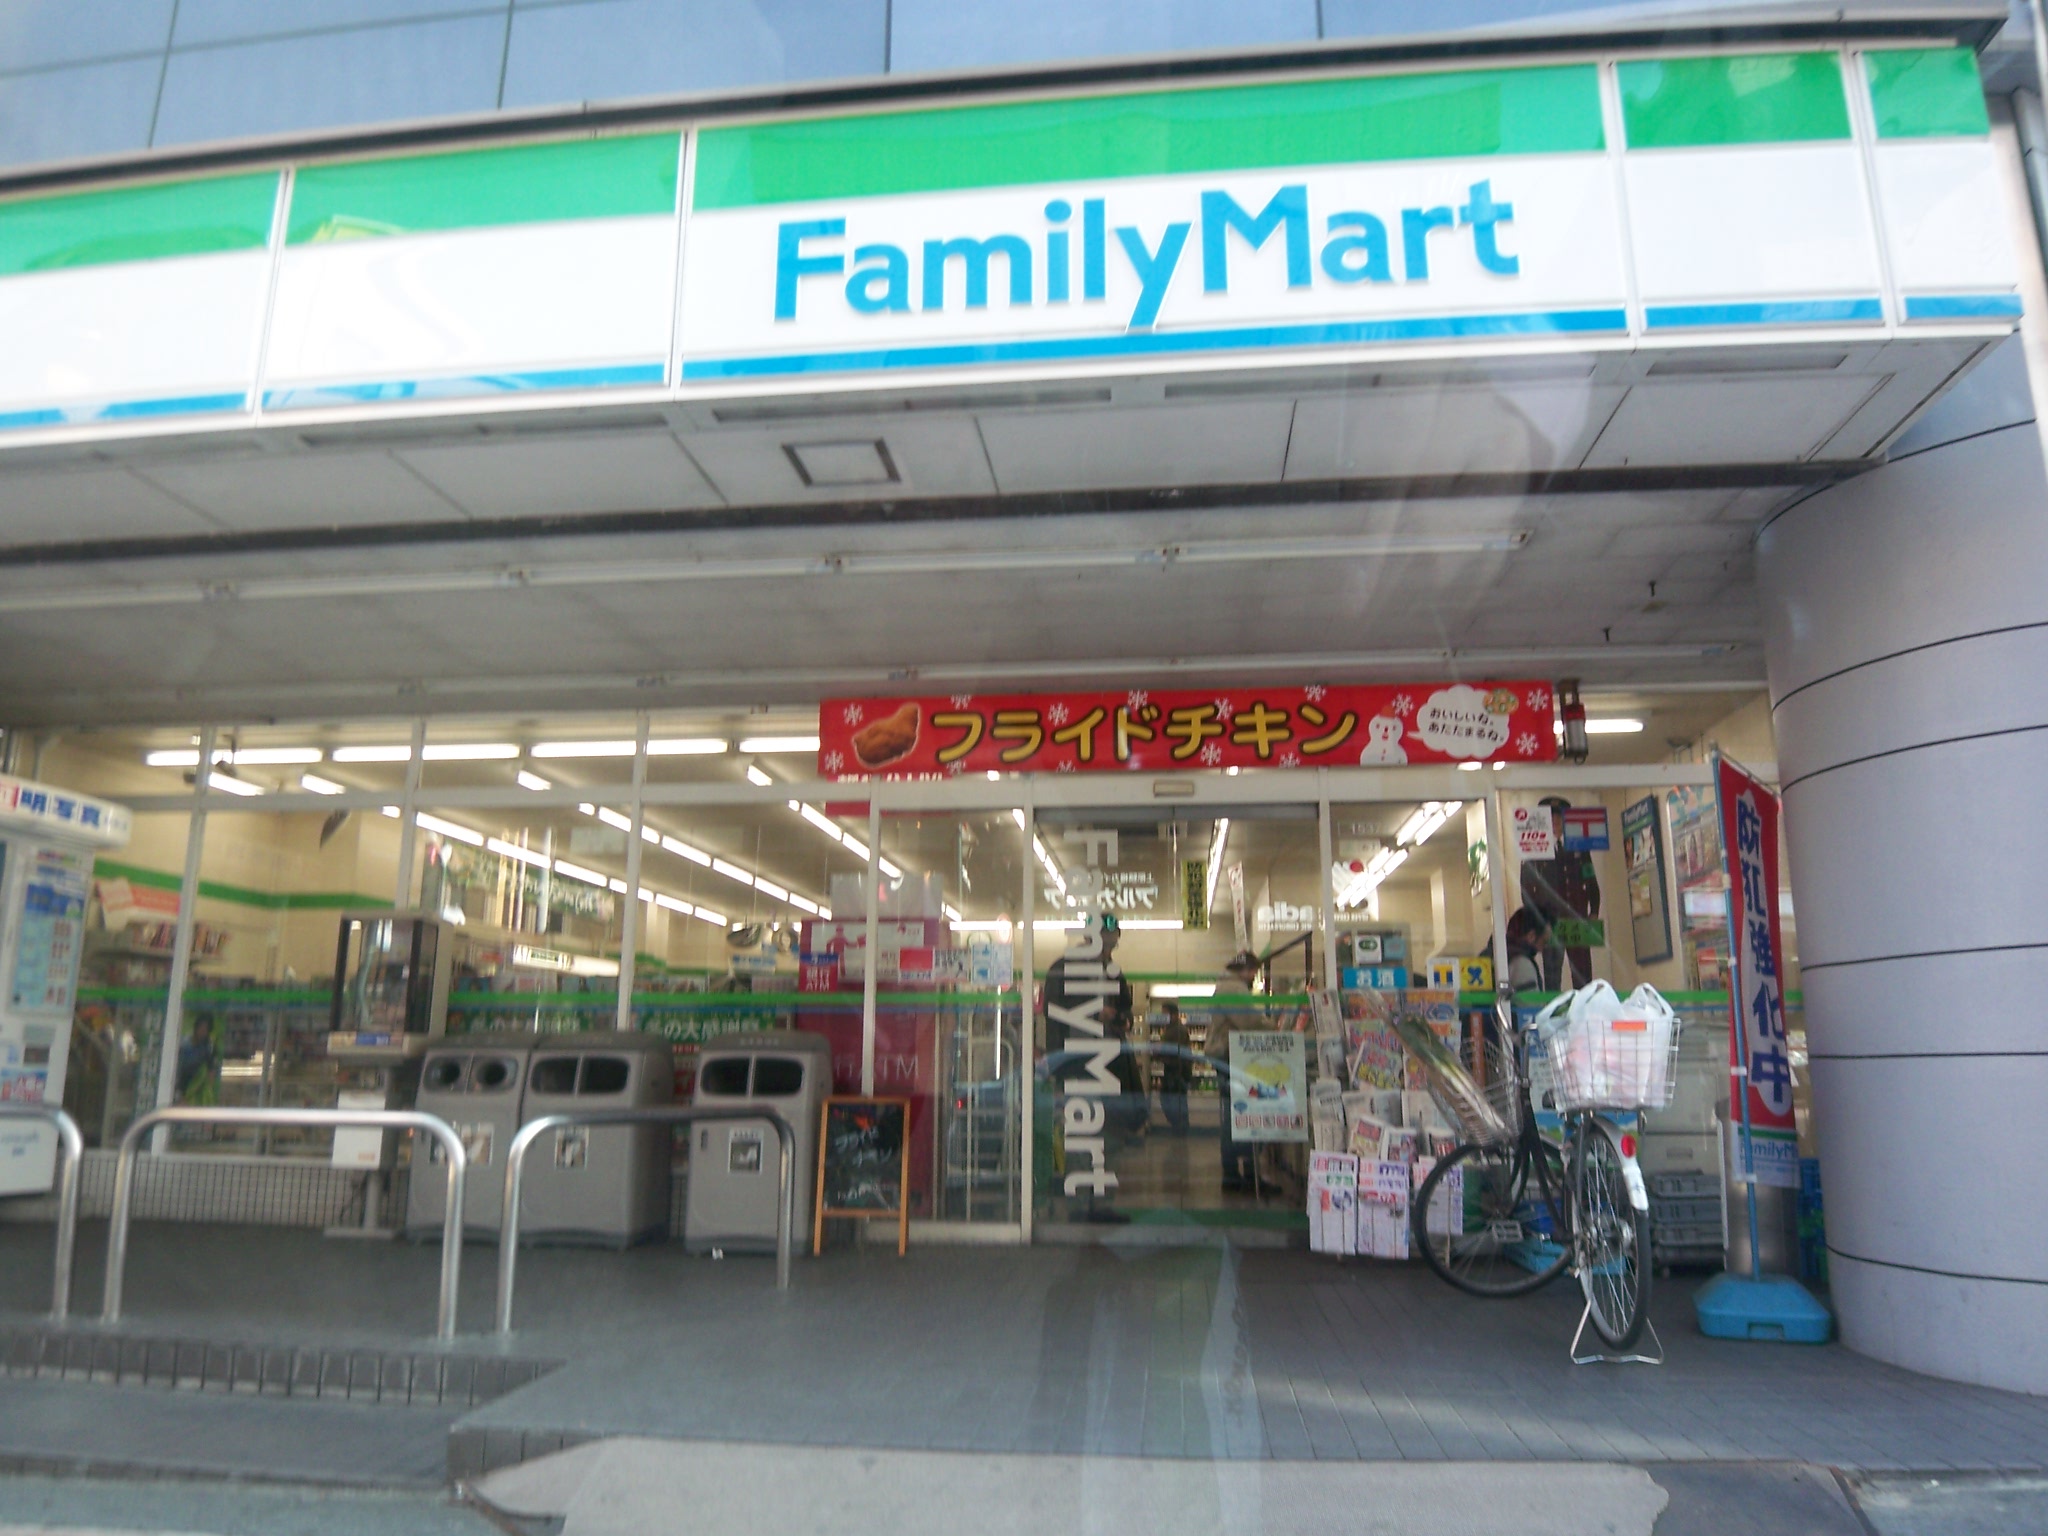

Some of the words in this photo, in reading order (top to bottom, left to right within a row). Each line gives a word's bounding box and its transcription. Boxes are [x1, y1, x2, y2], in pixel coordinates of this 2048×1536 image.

[773, 179, 1521, 334] FamilyMart
[930, 704, 1356, 764] フライドチキン
[1428, 721, 1504, 742] あたたまるね。
[1429, 707, 1494, 726] おいしいね。
[1736, 796, 1792, 1105] 防犯強化中
[1047, 829, 1121, 1198] FamilyMart
